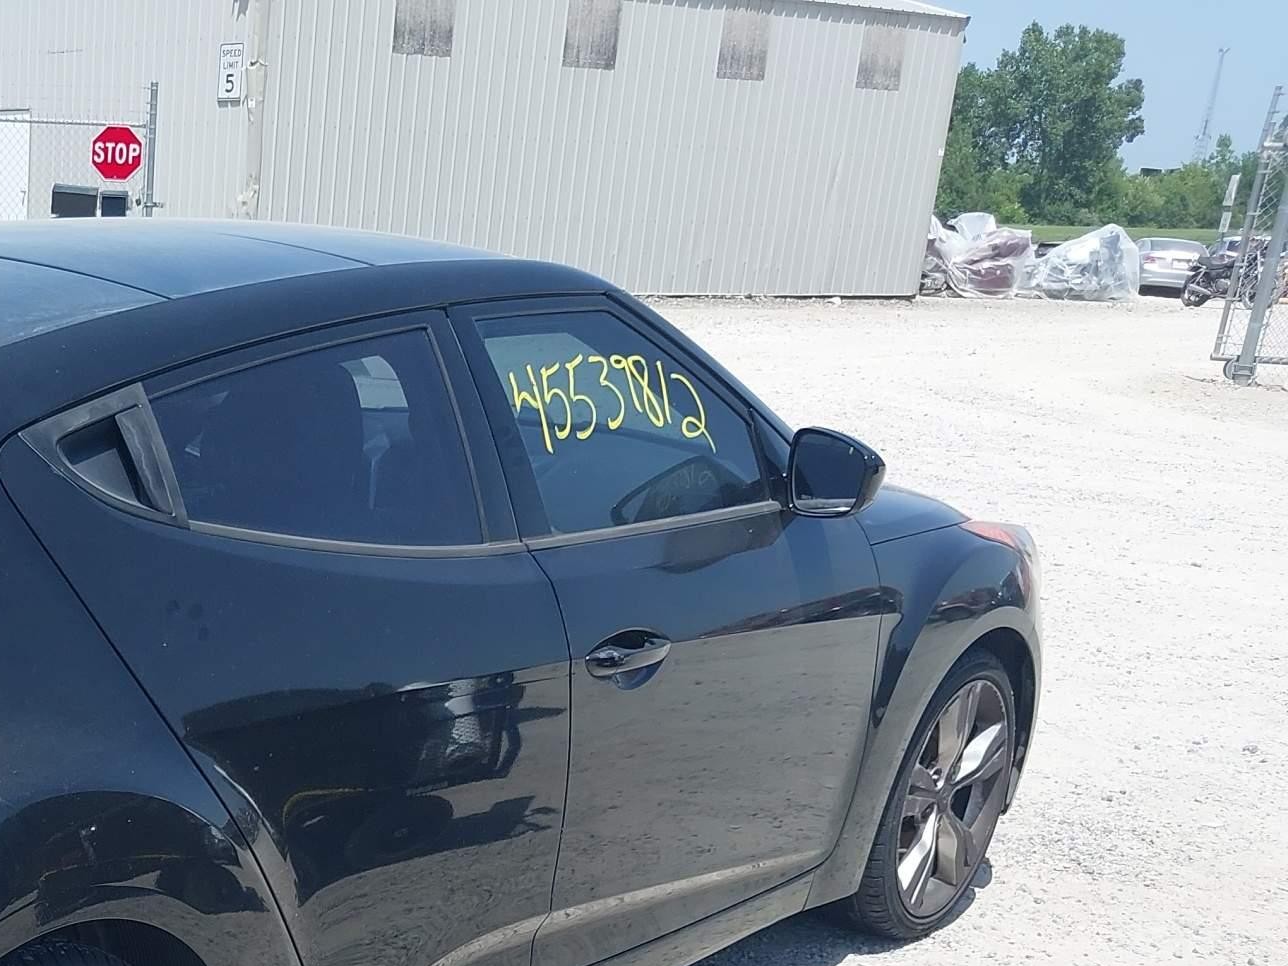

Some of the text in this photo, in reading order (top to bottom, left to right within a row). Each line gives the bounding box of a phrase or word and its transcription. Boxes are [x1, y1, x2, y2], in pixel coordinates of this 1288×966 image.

[222, 49, 242, 58] SPEED
[223, 61, 239, 70] LIMIT
[224, 73, 235, 93] 5
[93, 141, 141, 165] STOP
[508, 353, 717, 454] 45539812
